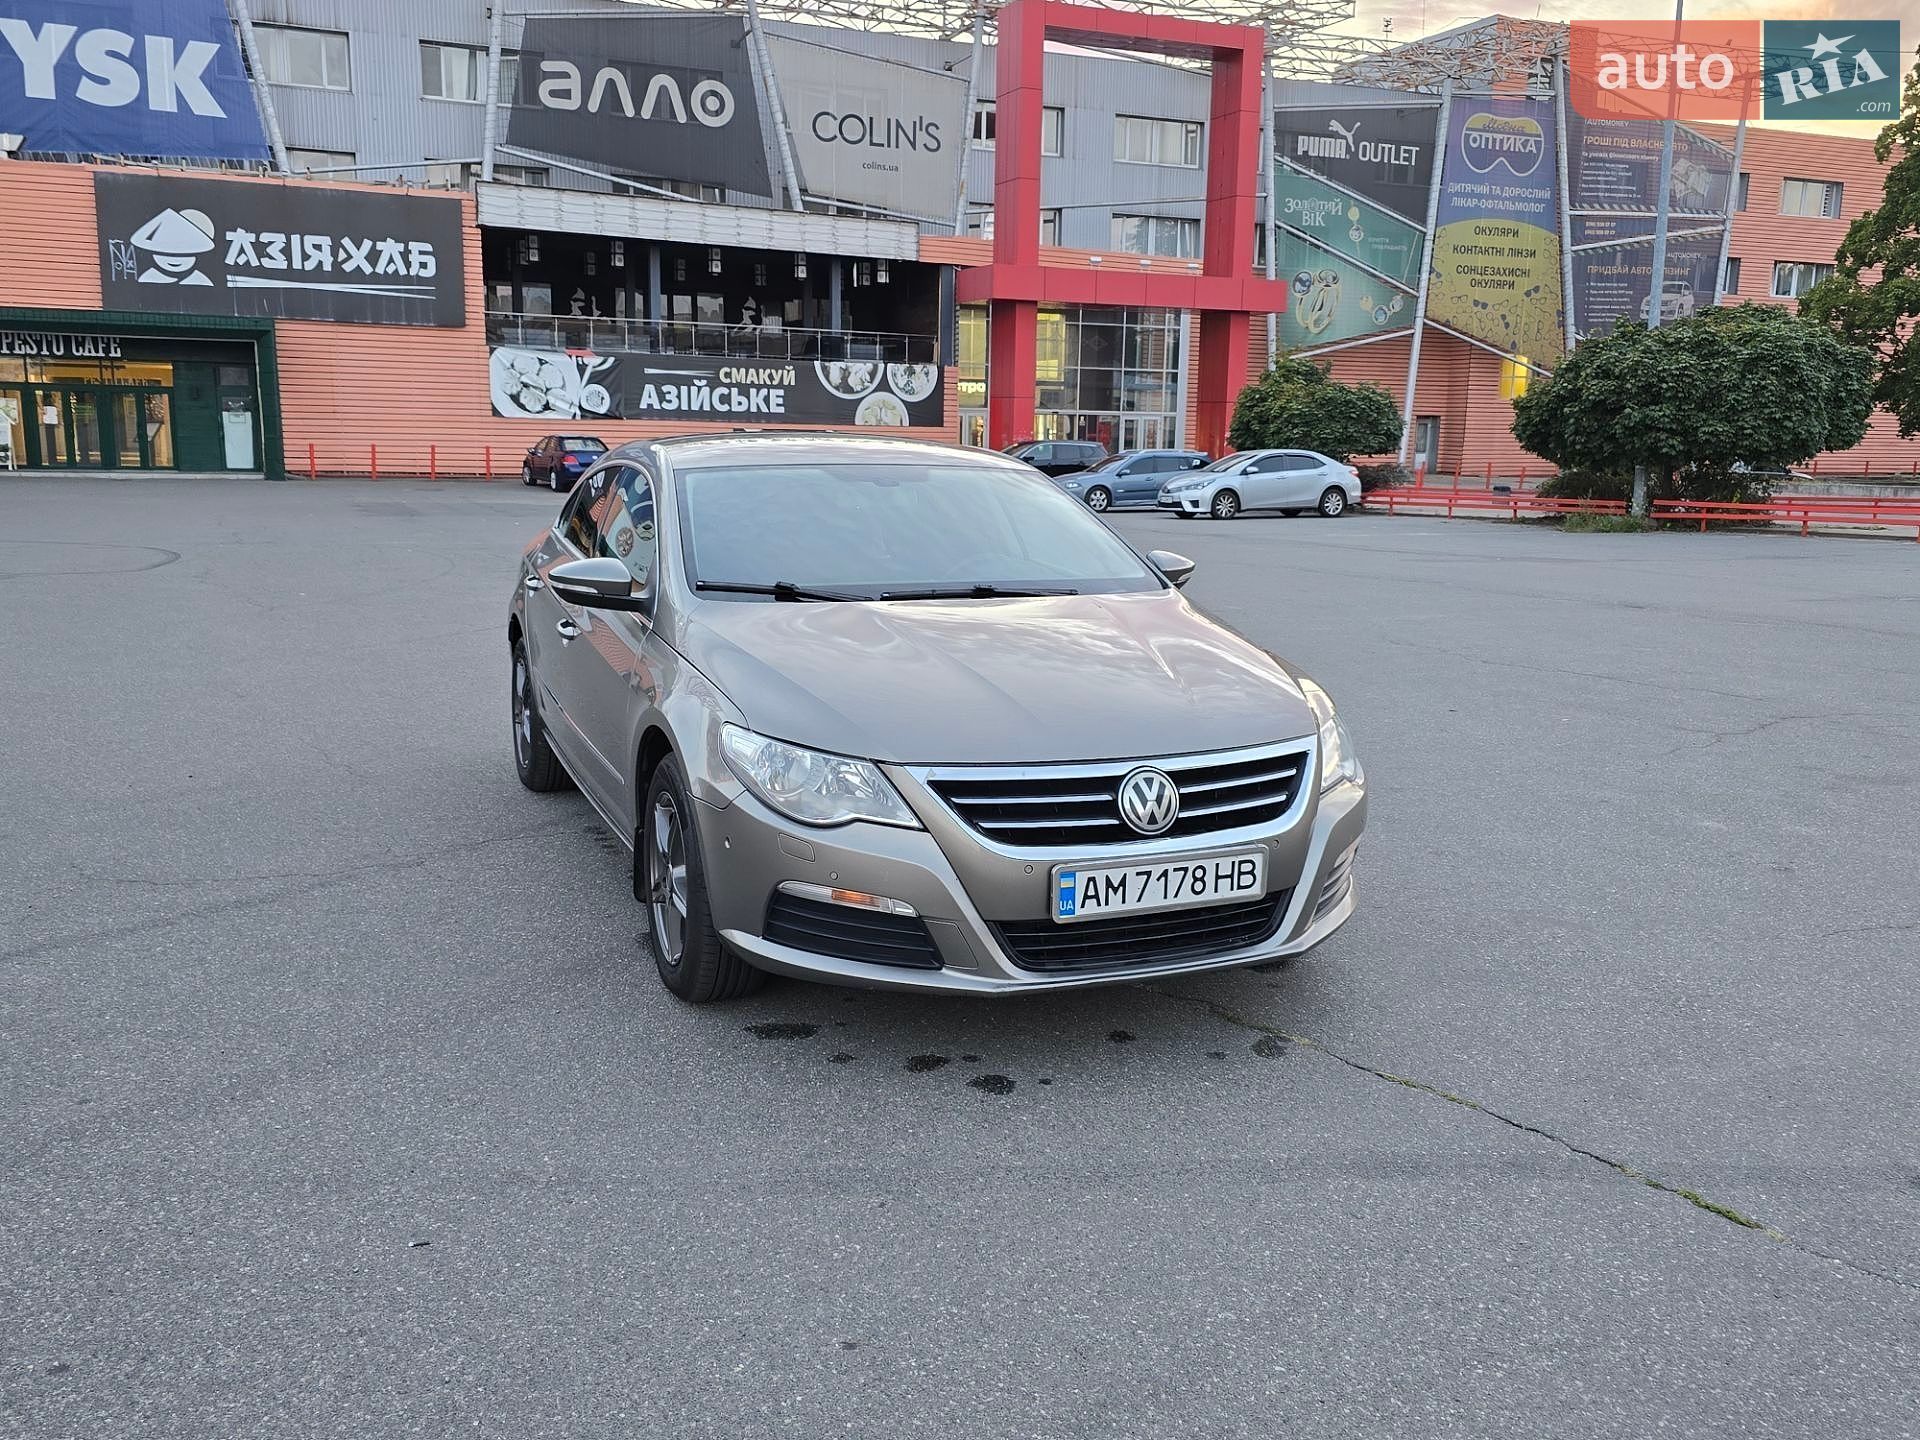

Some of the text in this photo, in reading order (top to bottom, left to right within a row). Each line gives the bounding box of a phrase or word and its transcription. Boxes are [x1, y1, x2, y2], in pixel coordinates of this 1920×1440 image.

[812, 111, 942, 152] COLIN'S
[1469, 133, 1537, 154] ОПТИКА
[1583, 136, 1612, 146] ГРОШІ
[1613, 137, 1629, 148] ПІД
[1297, 135, 1420, 166] PUMA OUTLET
[862, 161, 899, 173] colins.ua
[1447, 183, 1551, 200] ДИТЯЧИЙ ТА ДОРОСЛИЙ
[1451, 197, 1546, 213] ЛІКАР-ОФТАЛЬМОЛОГ
[1474, 225, 1519, 238] ОКУЛЯРИ
[1452, 244, 1536, 258] КОНТАКТНІ ЛІНЗИ
[1456, 264, 1530, 278] СОНЦЕЗАХИСНІ
[1587, 264, 1629, 276] ПРИДБАЙ
[1630, 266, 1652, 275] АВТО
[1470, 278, 1515, 290] ОКУЛЯРИ
[1, 331, 122, 357] PESTO CAFE
[719, 366, 796, 386] СМАКУЙ
[639, 379, 785, 413] АЗІЙСЬКЕ
[1080, 859, 1257, 909] AM 7178 HB
[1059, 900, 1074, 911] UA
